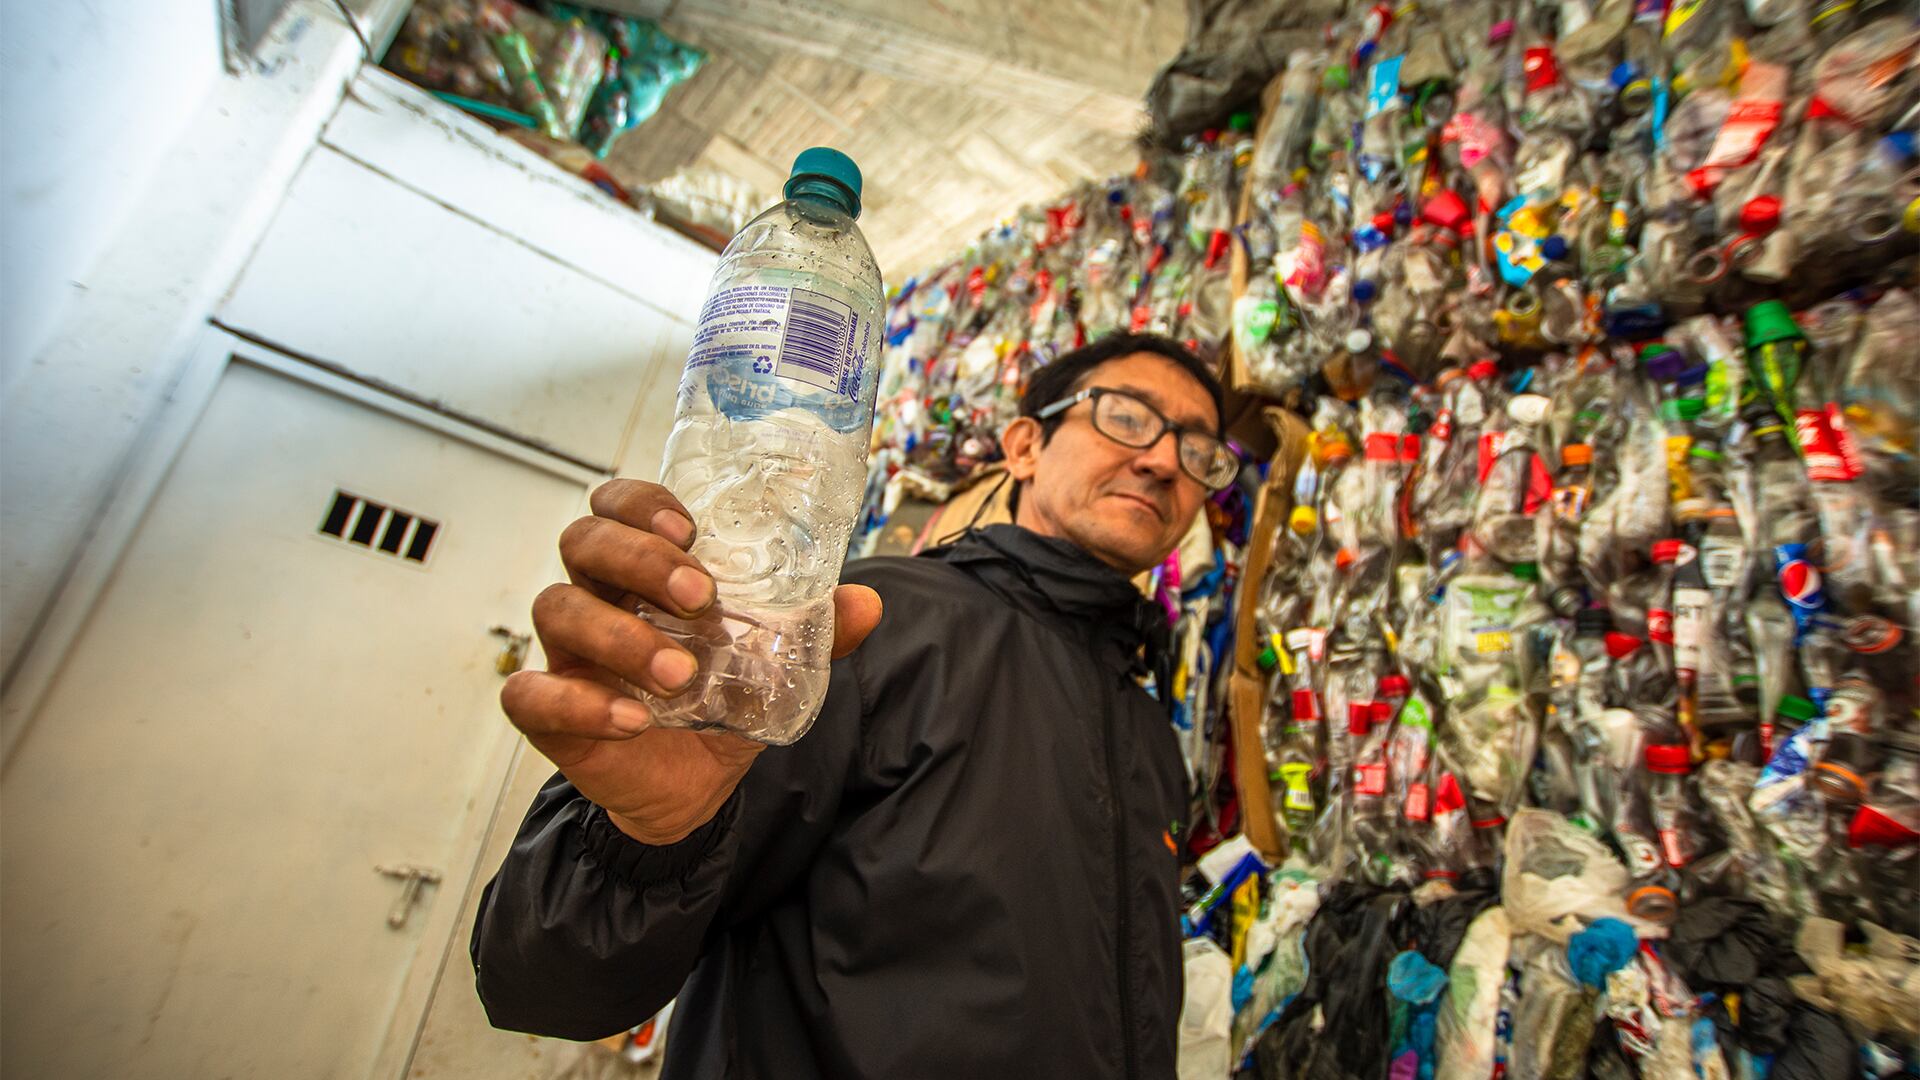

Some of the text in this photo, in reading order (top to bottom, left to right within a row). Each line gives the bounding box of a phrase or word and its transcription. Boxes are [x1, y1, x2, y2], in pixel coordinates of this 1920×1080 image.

[832, 348, 842, 376] 702535
[837, 316, 847, 346] 010327
[839, 311, 859, 396] ENVASE NO RETORNABLE
